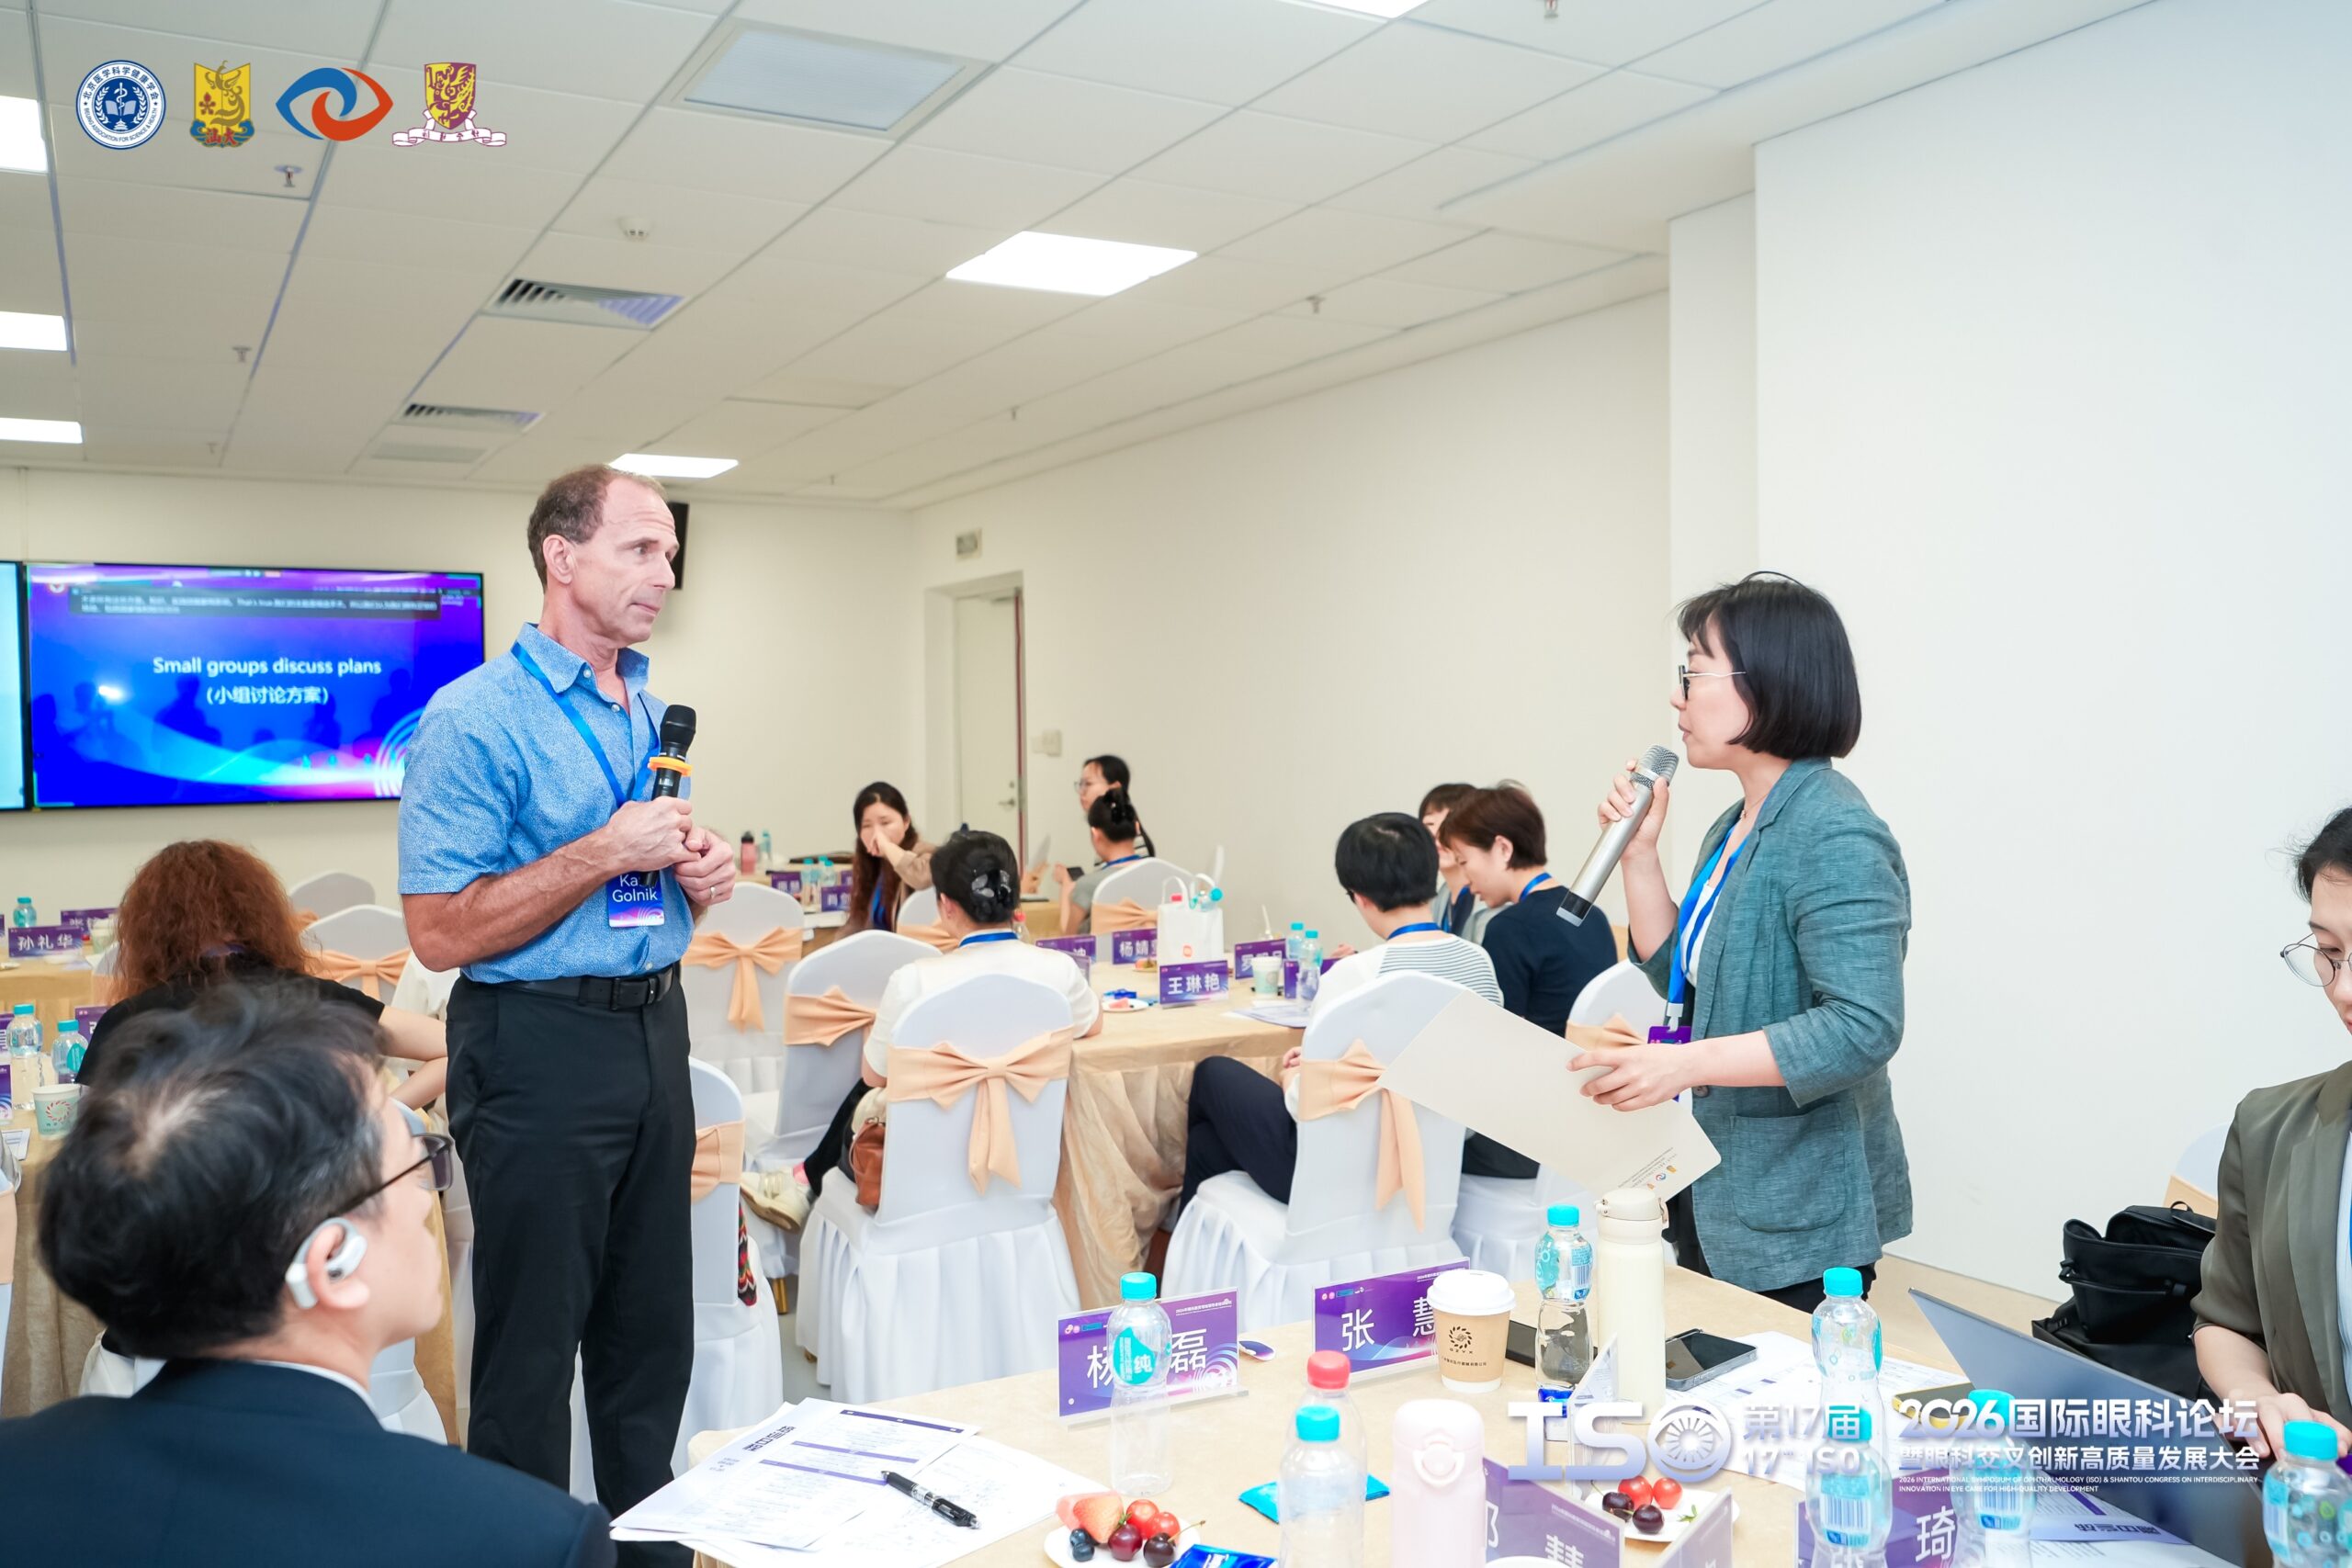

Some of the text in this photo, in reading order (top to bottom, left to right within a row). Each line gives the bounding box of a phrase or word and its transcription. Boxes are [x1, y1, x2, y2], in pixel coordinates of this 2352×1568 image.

[153, 657, 382, 677] Small groups discuss plans
[612, 887, 659, 903] Golnik
[17, 933, 74, 951] 孙礼华
[1168, 973, 1220, 995] 王琳艳
[1341, 1309, 1375, 1352] 张
[1170, 1328, 1208, 1373] 磊
[1915, 1506, 1956, 1562] 琦
